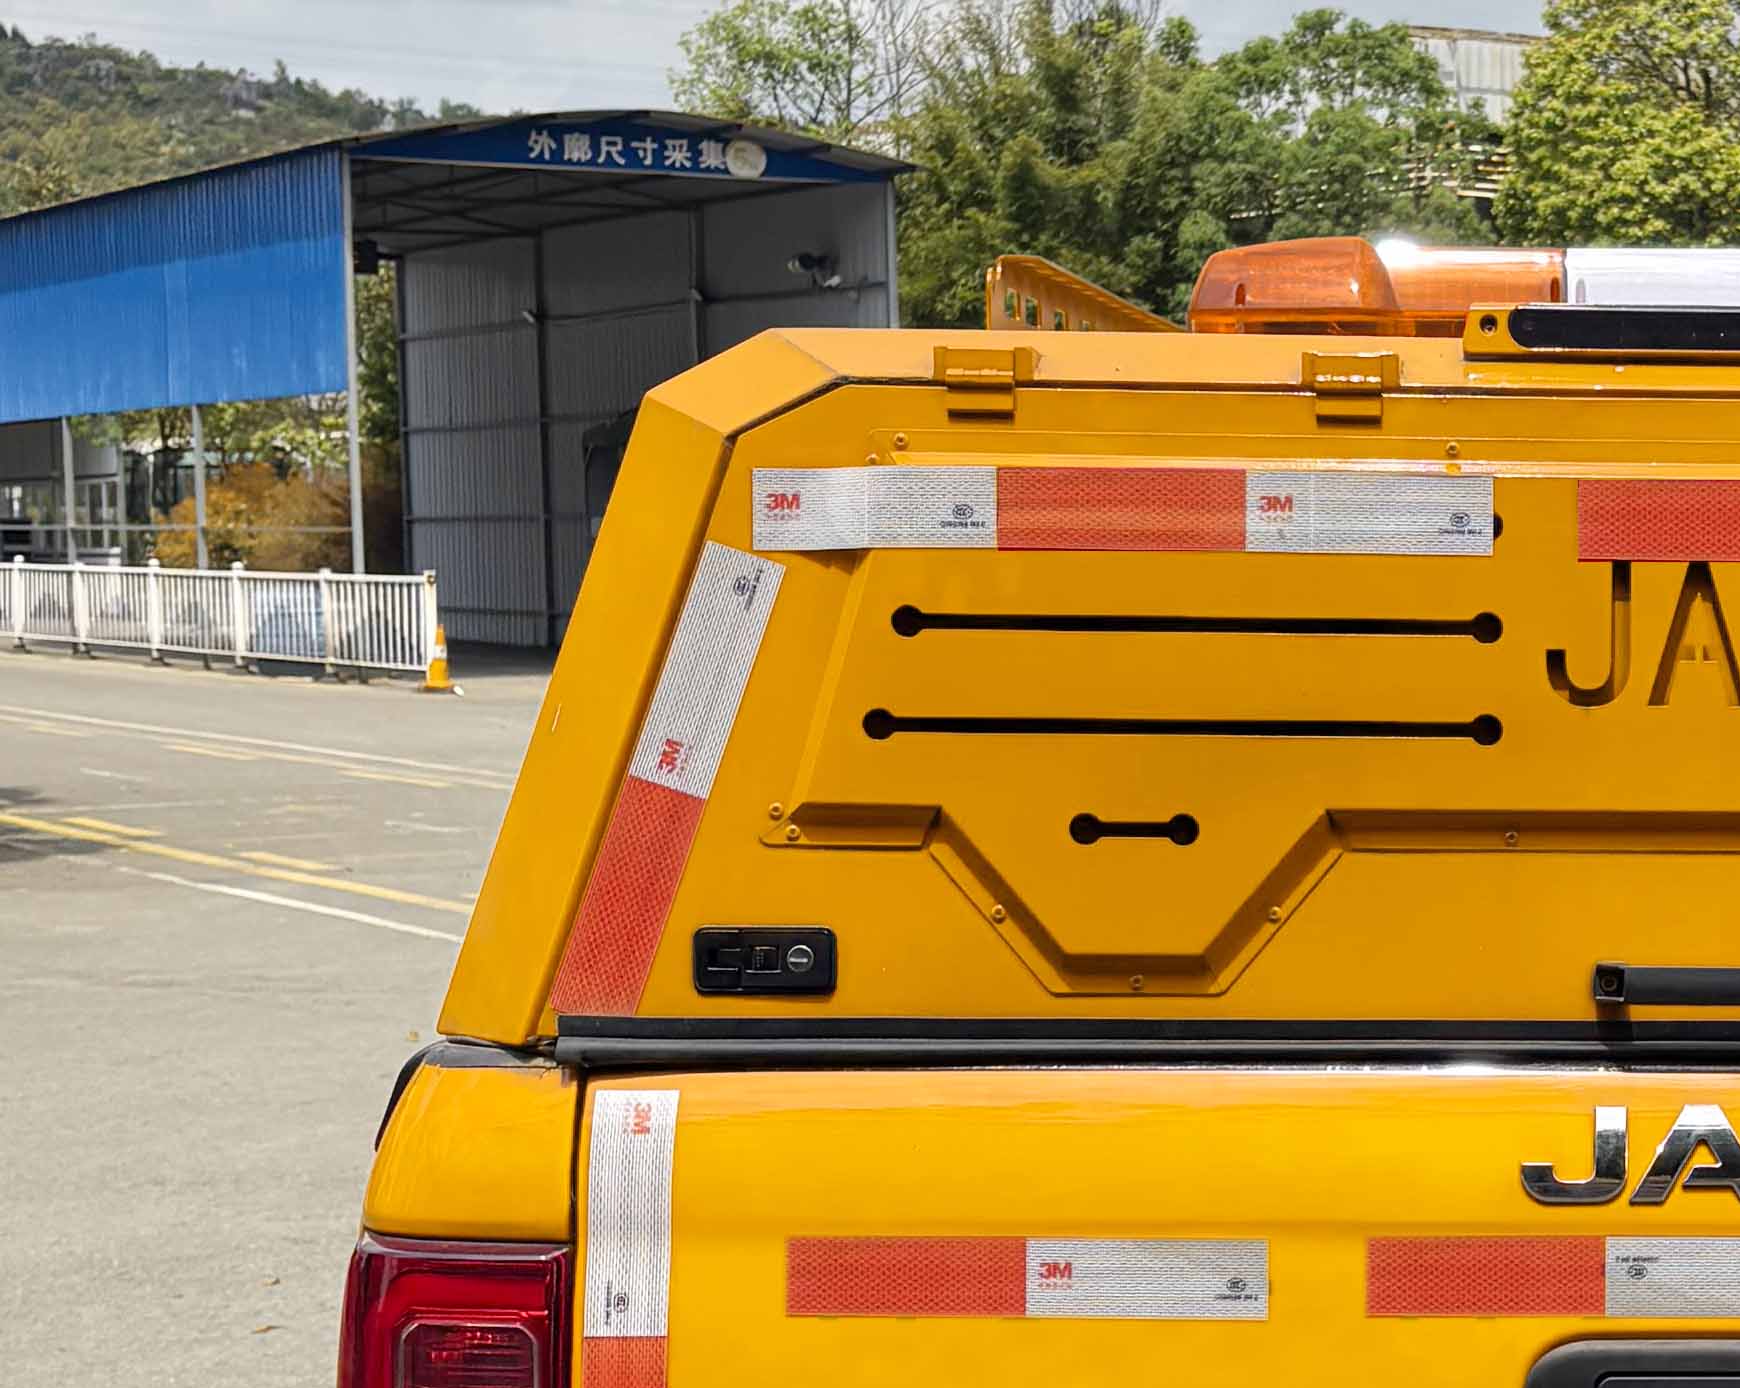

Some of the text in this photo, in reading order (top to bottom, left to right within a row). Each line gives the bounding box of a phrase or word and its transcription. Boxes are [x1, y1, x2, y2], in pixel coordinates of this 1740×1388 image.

[766, 493, 801, 511] 3M
[1258, 495, 1294, 513] 3M
[656, 738, 684, 774] 3M
[632, 1102, 652, 1137] 3M
[1039, 1262, 1073, 1281] 3M
